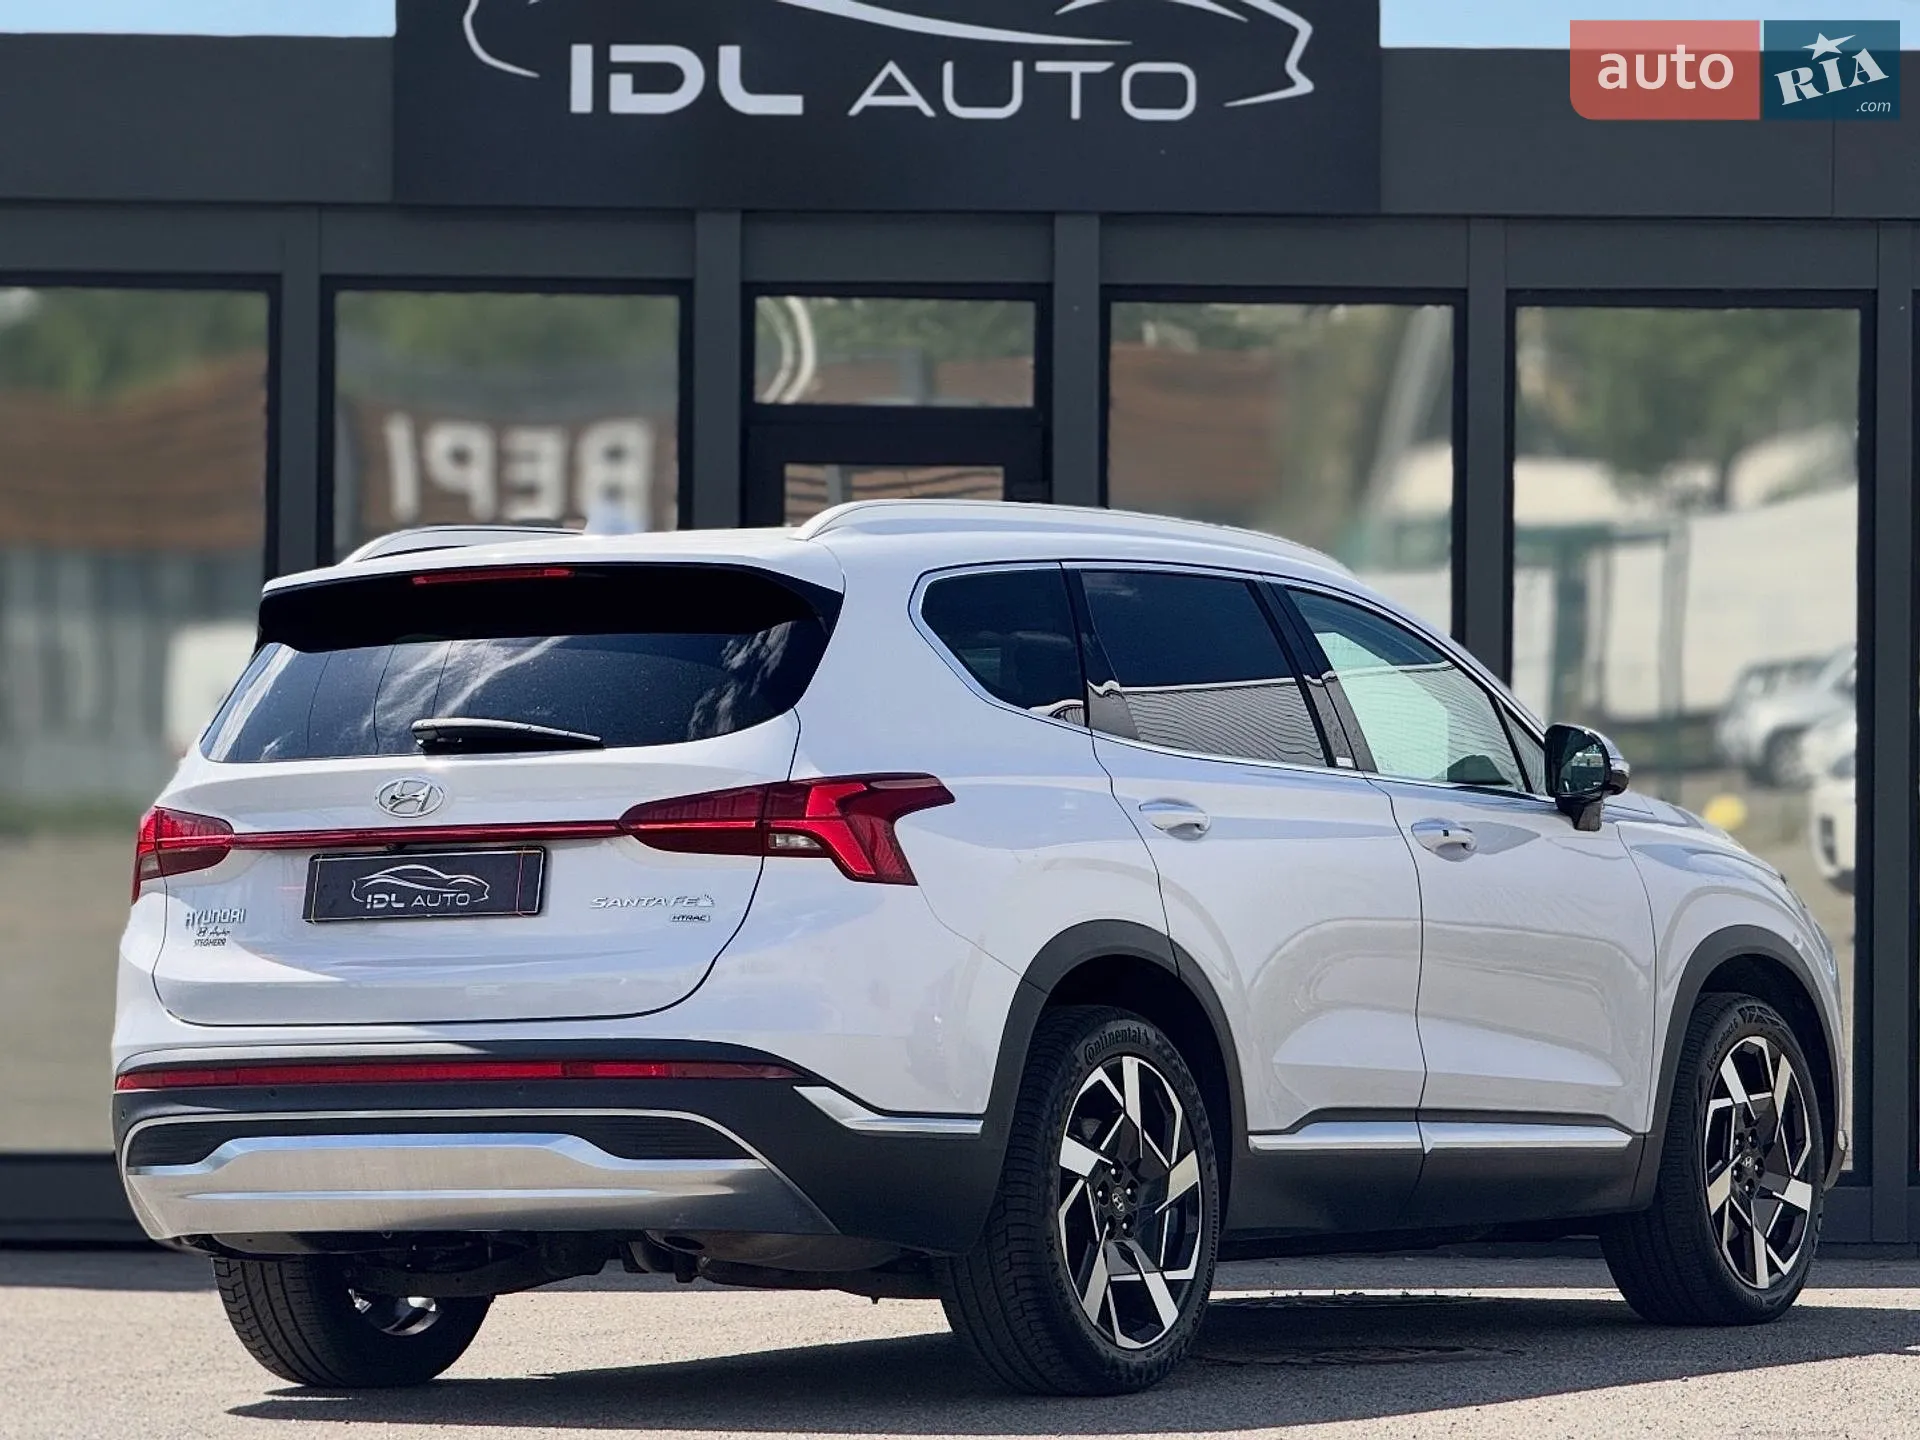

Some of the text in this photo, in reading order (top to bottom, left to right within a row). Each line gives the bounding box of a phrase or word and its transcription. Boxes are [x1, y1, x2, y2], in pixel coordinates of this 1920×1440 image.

[570, 43, 1198, 120] IDL AUTO
[365, 893, 471, 909] IDL AUTO
[590, 896, 700, 909] SANTA FE
[184, 908, 247, 927] HYUNDAI
[672, 914, 706, 922] HTRAC
[1084, 1027, 1142, 1066] Continental
